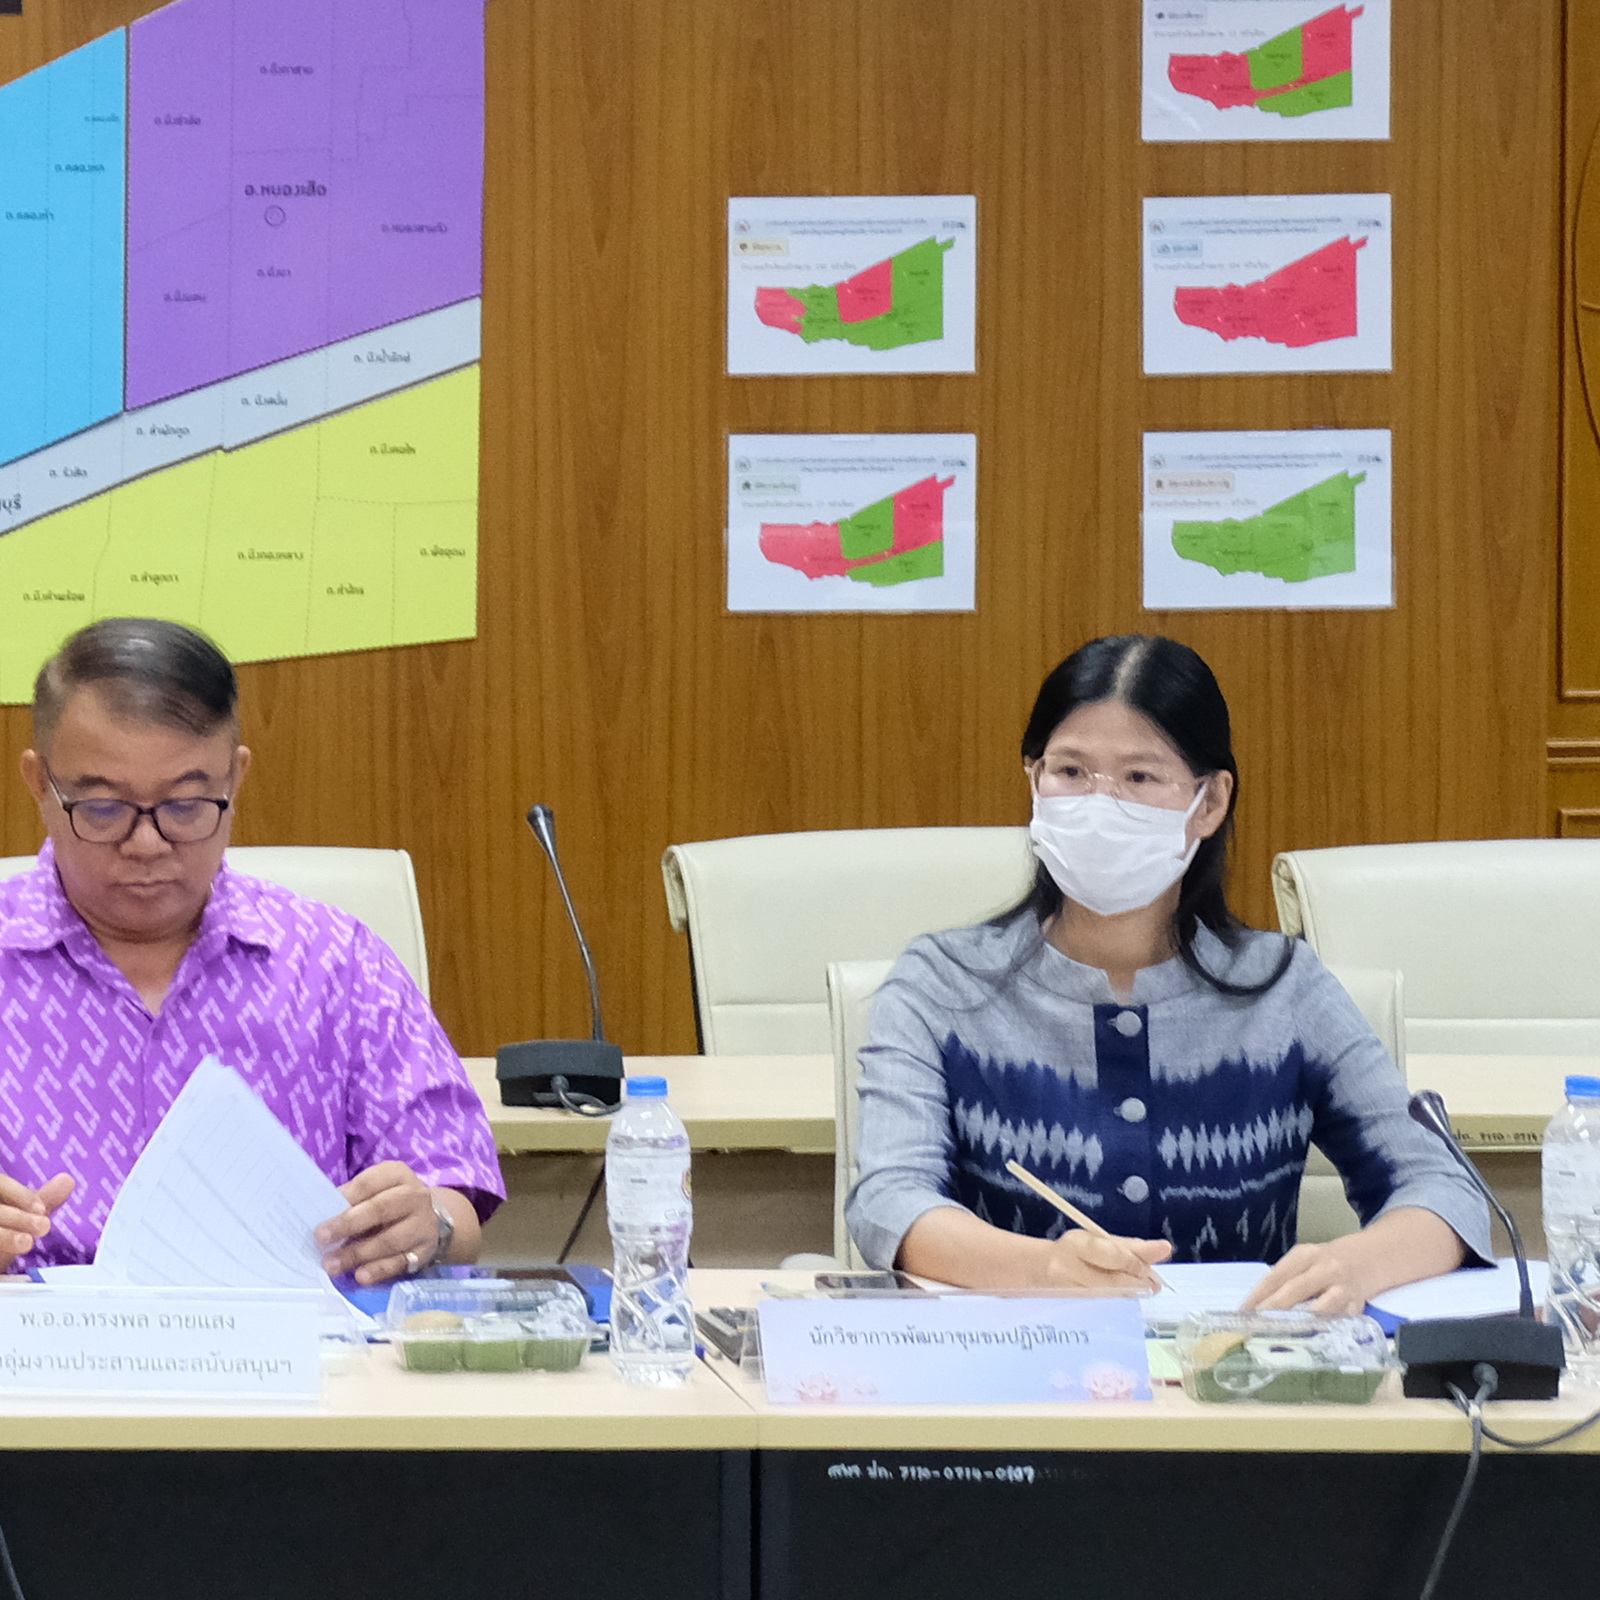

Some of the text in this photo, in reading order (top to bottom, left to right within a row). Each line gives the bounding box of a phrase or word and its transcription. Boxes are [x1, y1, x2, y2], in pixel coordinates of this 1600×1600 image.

[809, 1325, 1090, 1352] นักวิชาการพัฒนาชุมชนปฏิบัติการ
